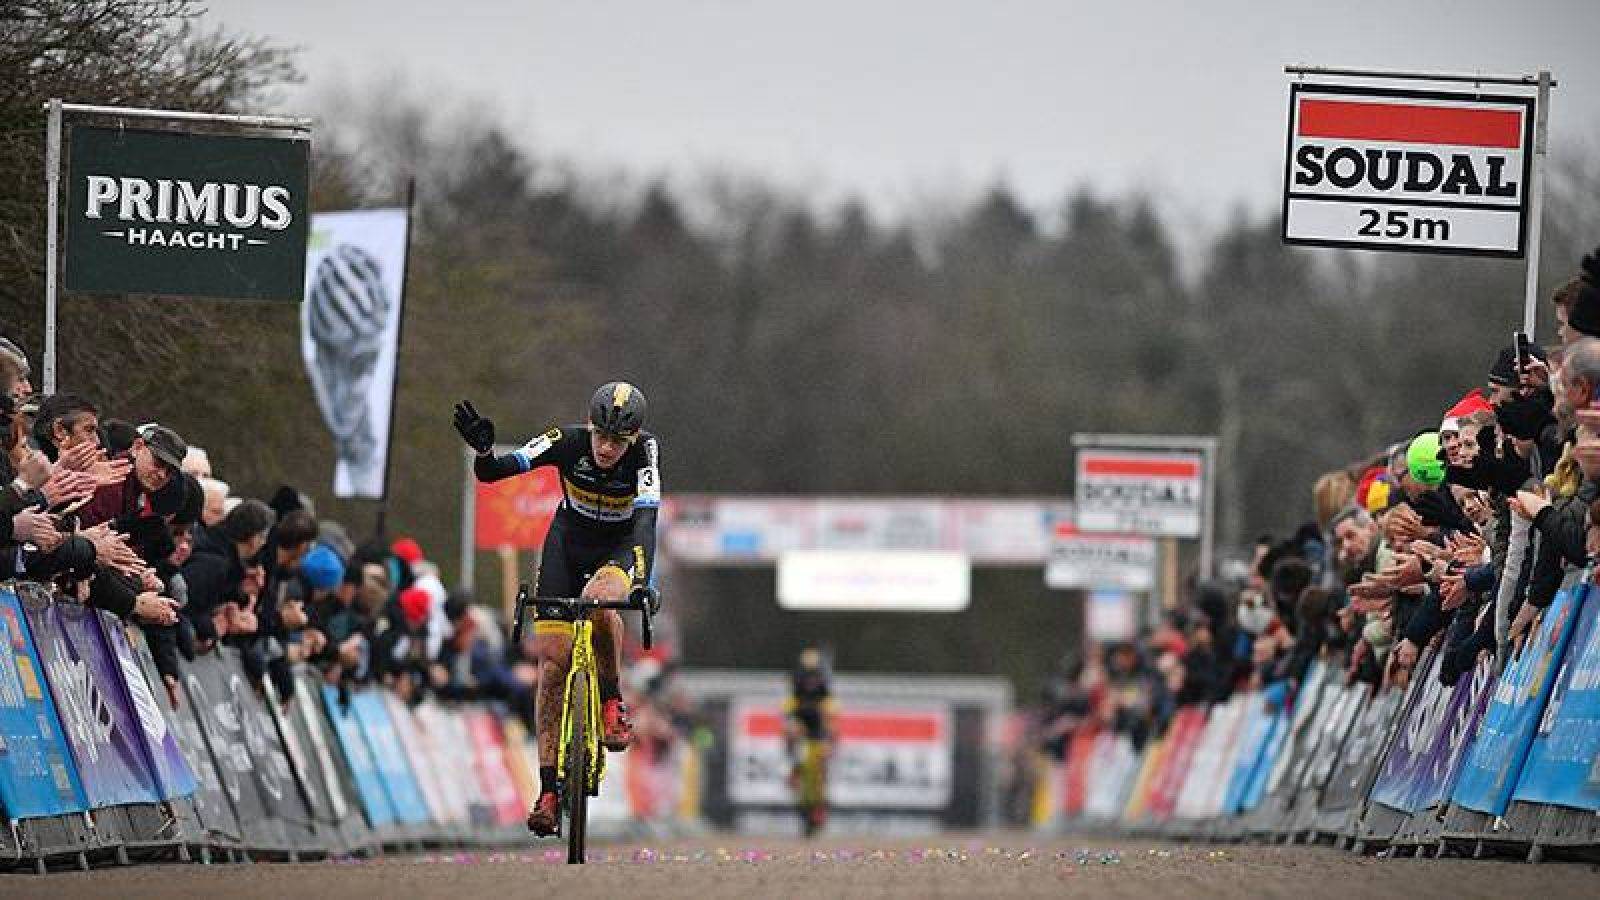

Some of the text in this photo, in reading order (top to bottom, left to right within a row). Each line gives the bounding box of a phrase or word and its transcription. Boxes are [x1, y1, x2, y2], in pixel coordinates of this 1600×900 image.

[1295, 145, 1517, 197] SOUDAL
[85, 175, 292, 230] PRIMUS
[127, 227, 245, 250] HAACHT
[1357, 208, 1450, 241] 25m
[643, 469, 653, 486] 3
